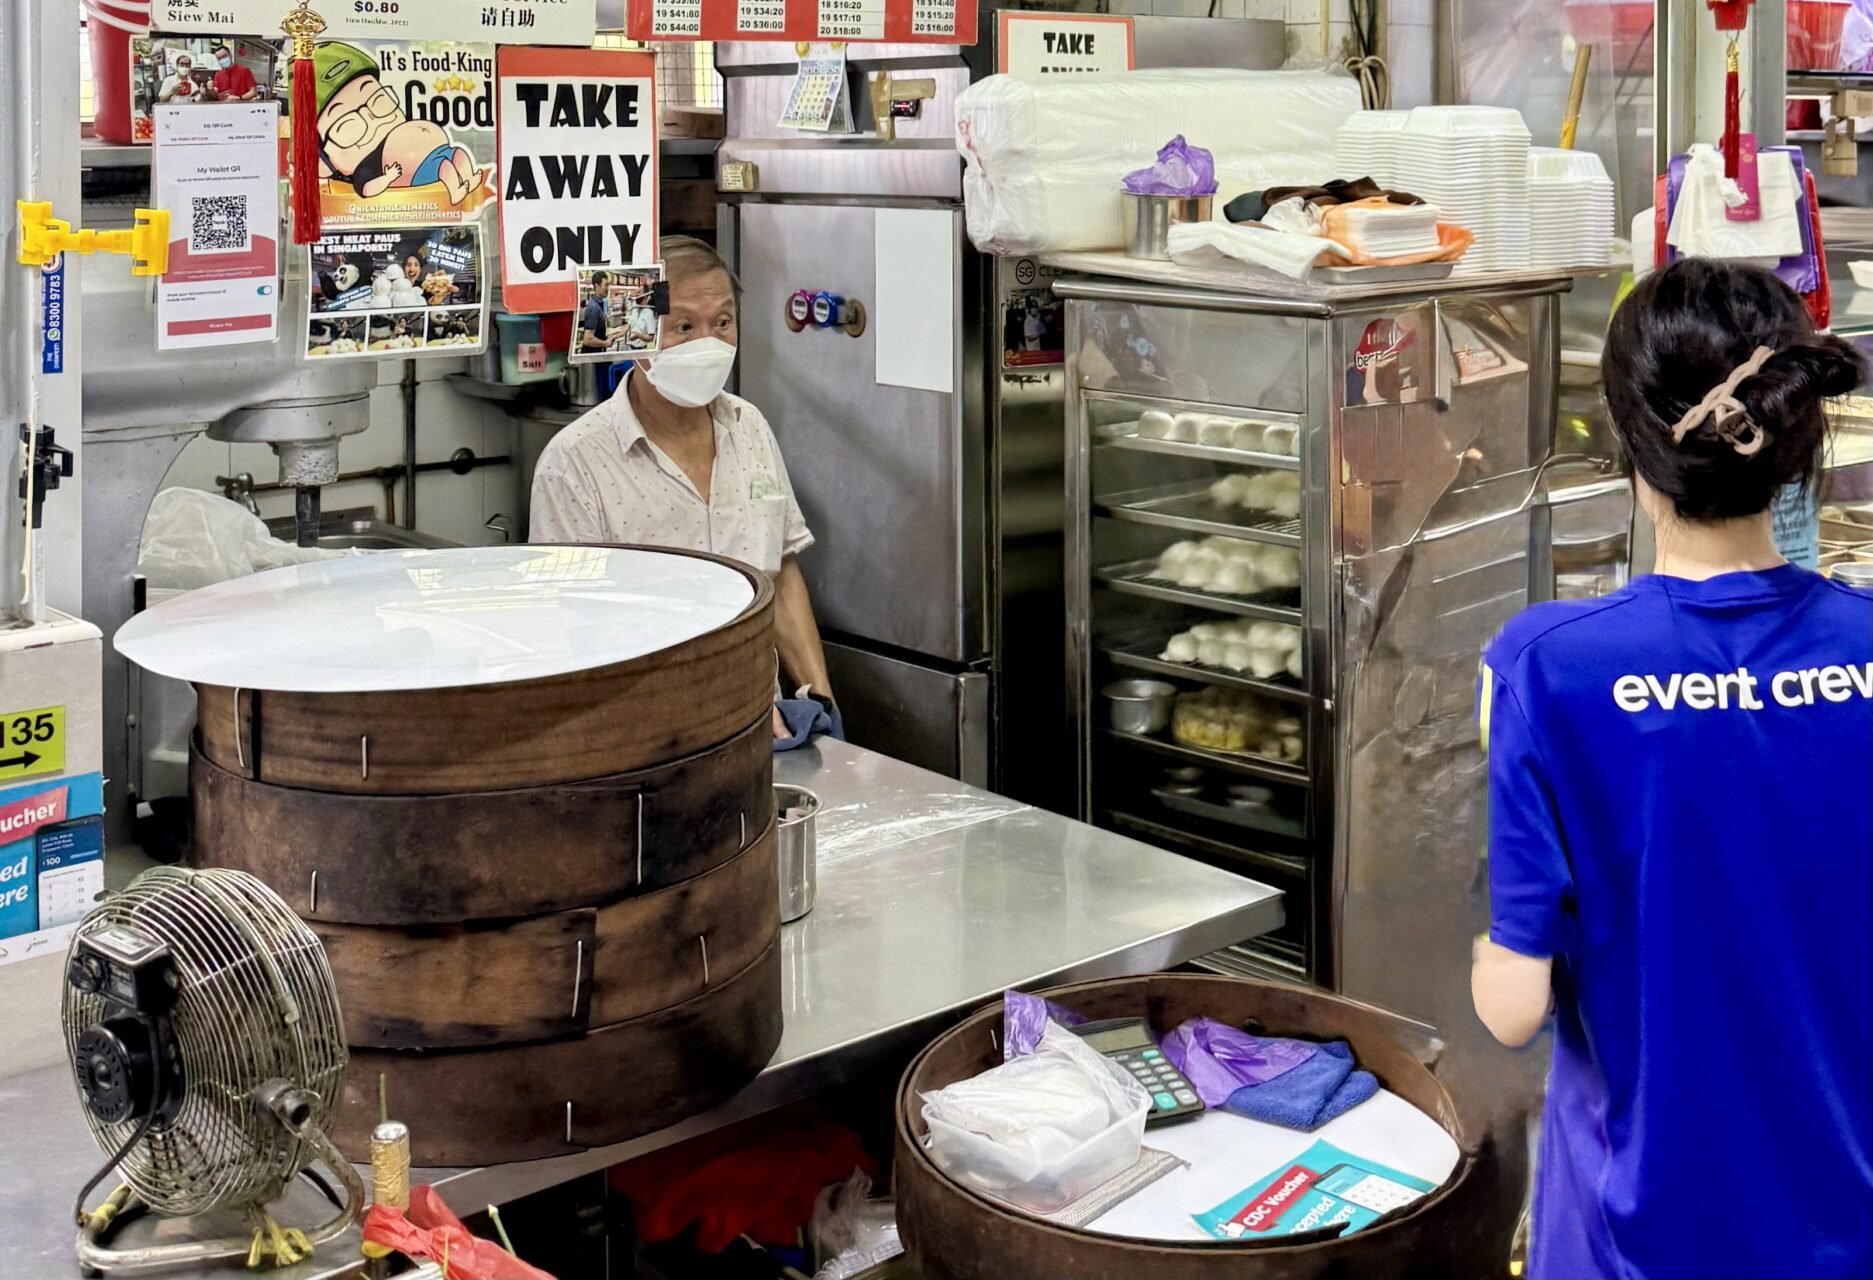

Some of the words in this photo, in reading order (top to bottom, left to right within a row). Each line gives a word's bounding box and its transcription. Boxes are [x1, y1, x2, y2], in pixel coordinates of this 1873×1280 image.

[168, 10, 204, 22] Siew
[208, 11, 234, 23] Mai
[354, 0, 399, 14] $0.80
[482, 7, 535, 27] 请自助
[656, 9, 667, 18] 19
[655, 23, 667, 32] 20
[740, 20, 751, 28] 20
[820, 26, 831, 35] 20
[1043, 32, 1095, 55] TAKE
[381, 50, 406, 71] It's
[412, 51, 492, 79] Food-King
[405, 79, 494, 128] Good
[516, 83, 639, 129] TAKE
[505, 154, 650, 201] AWAY
[313, 244, 325, 254] IN
[318, 235, 341, 245] EST
[343, 234, 373, 244] MEAT
[374, 233, 401, 243] PAUS
[520, 224, 642, 273] ONLY
[1019, 266, 1033, 278] SG
[49, 274, 61, 300] 9783
[49, 302, 61, 327] 8300
[1613, 666, 1764, 712] event
[0, 801, 57, 833] ucher
[1242, 1204, 1272, 1228] CDC
[1263, 1171, 1310, 1206] Voucher
[1289, 1196, 1337, 1234] ccepted
